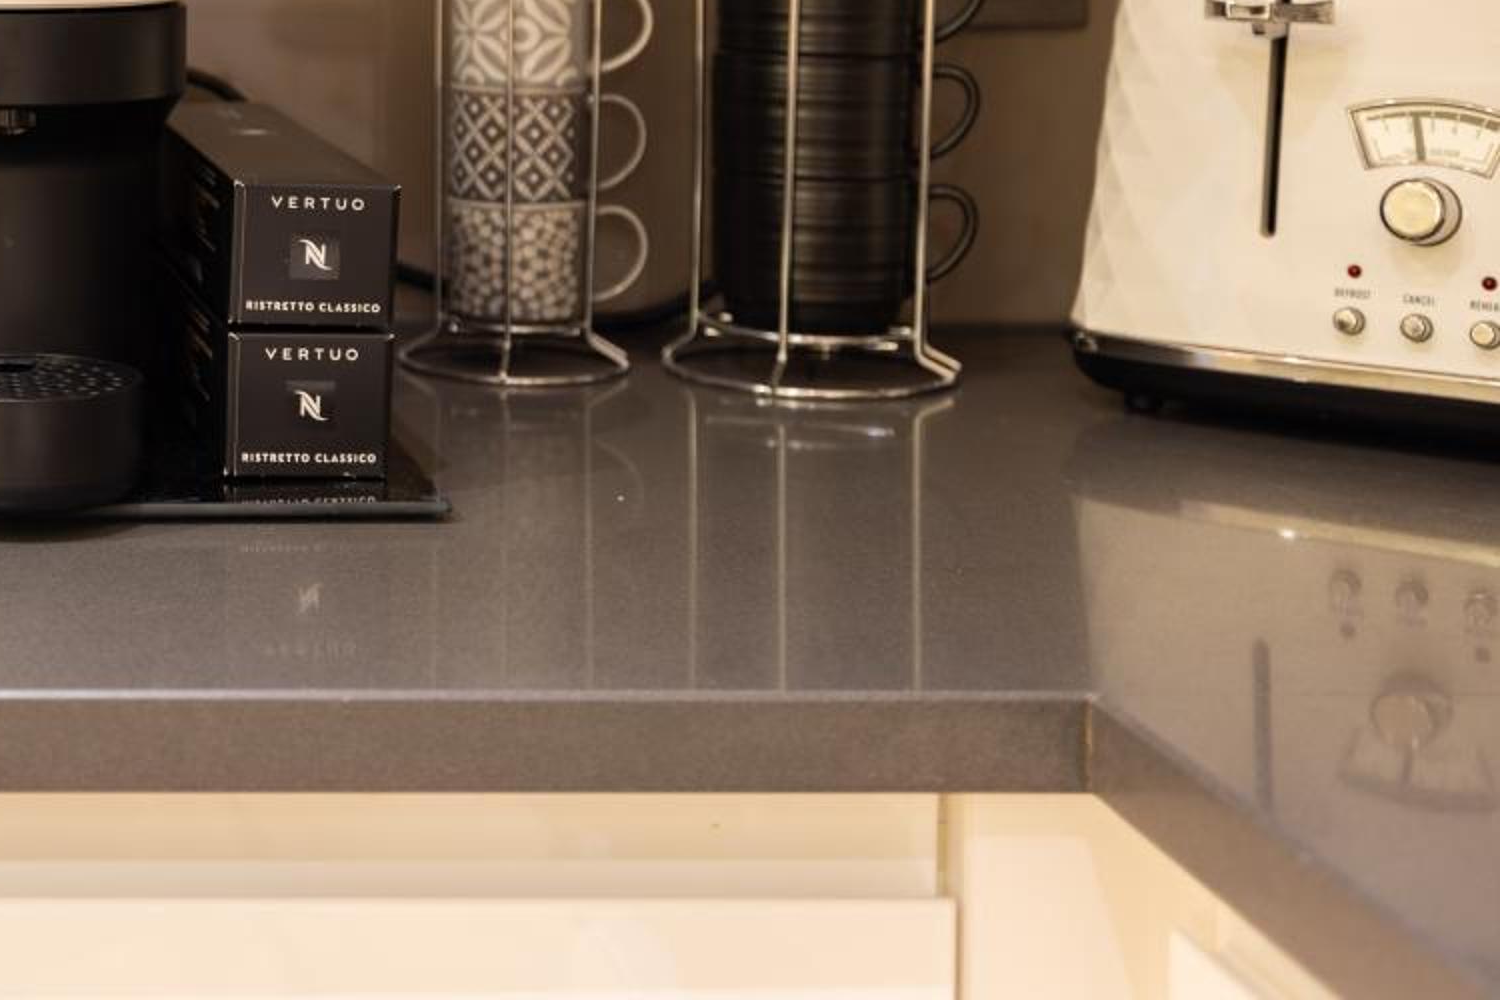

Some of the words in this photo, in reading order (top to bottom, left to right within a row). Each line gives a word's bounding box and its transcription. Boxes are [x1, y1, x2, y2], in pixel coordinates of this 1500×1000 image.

[271, 196, 365, 211] VERTUO
[245, 300, 315, 313] RISTRETTO
[319, 301, 381, 314] CLASSICO
[265, 348, 359, 361] VERTUO
[241, 452, 311, 464] RISTRETTO
[315, 452, 377, 464] CLASSICO
